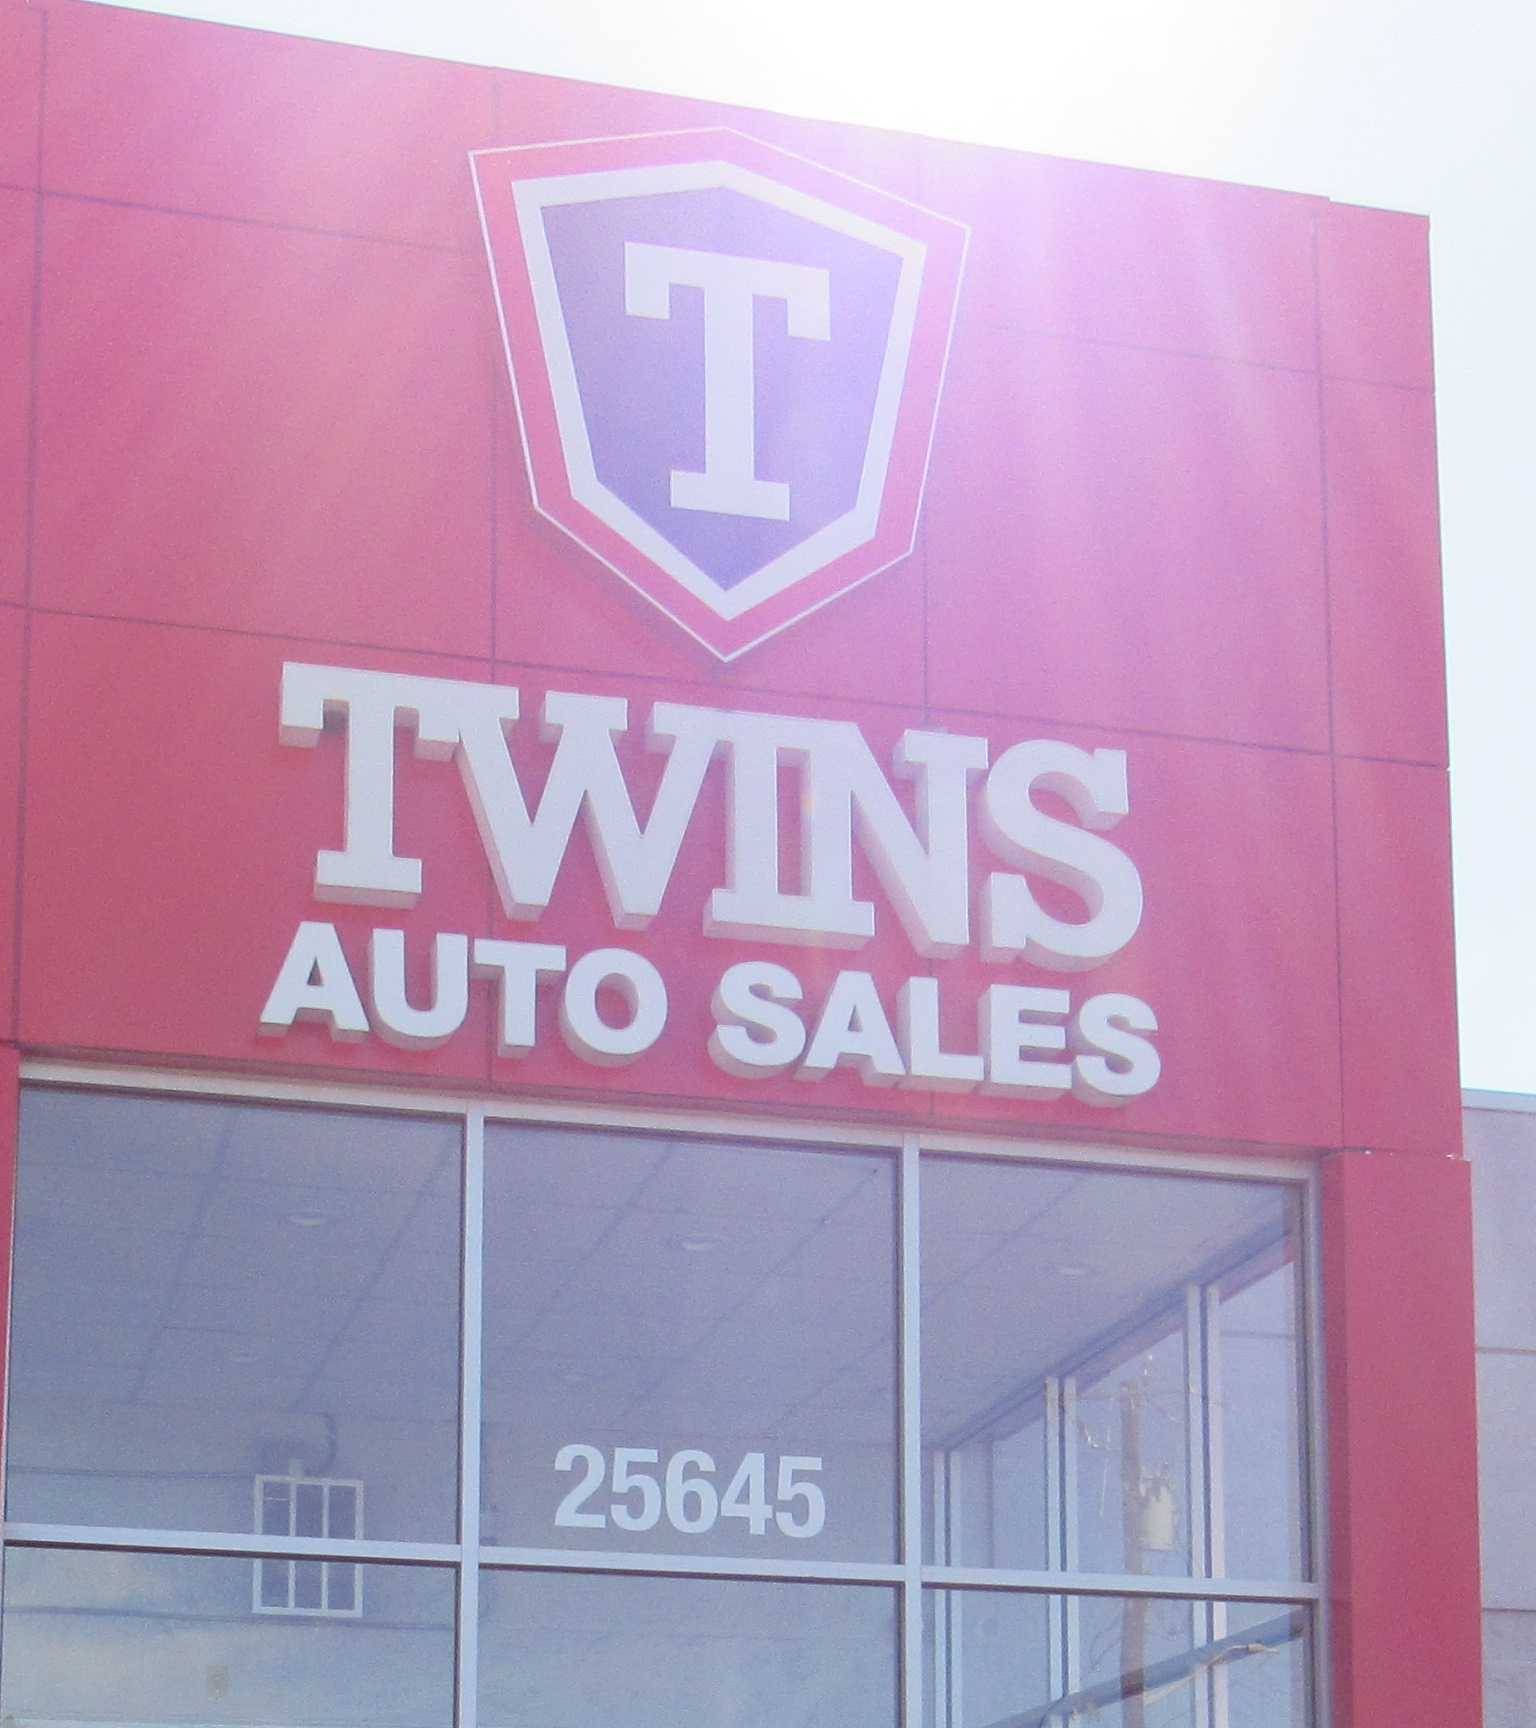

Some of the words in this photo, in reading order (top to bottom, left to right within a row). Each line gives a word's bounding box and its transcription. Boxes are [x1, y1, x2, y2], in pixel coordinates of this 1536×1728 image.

[624, 241, 831, 521] T
[279, 662, 1144, 972] TWINS
[260, 921, 667, 1066] AUTO
[709, 961, 1161, 1108] SALES
[553, 1443, 826, 1539] 25645
